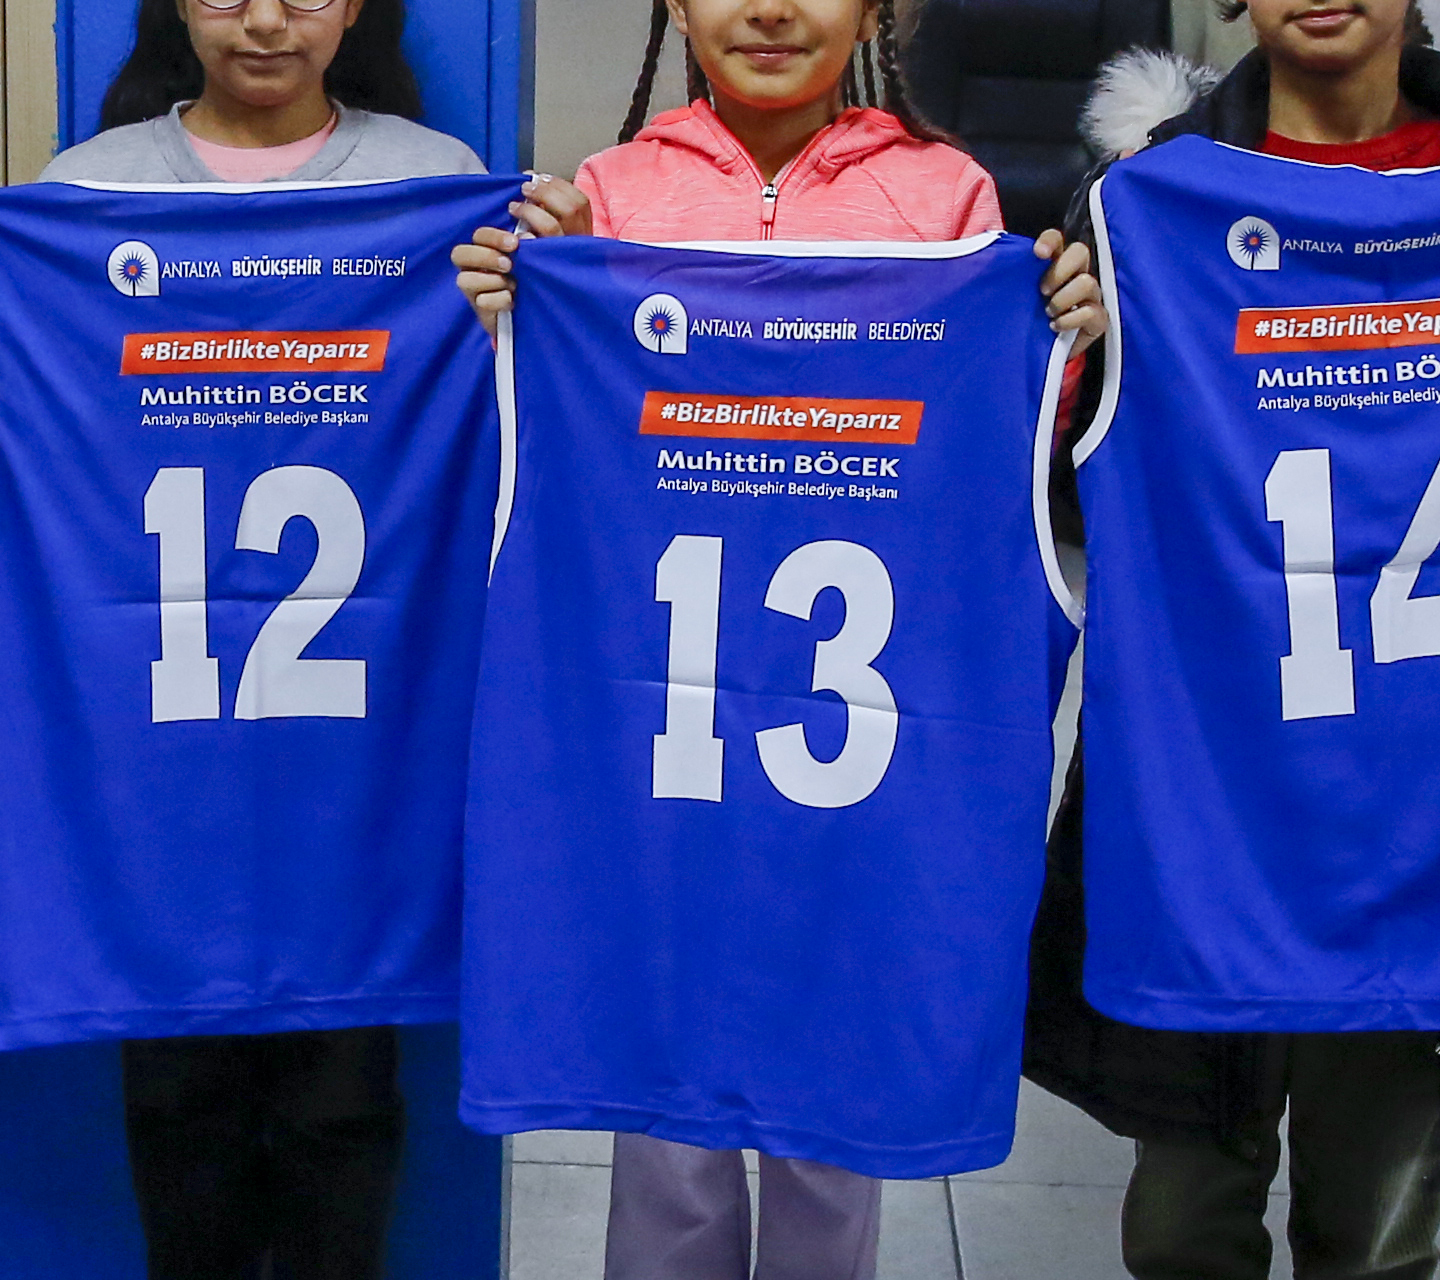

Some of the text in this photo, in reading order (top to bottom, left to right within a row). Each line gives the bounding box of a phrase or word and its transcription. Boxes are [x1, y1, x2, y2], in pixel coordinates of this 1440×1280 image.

[1282, 238, 1344, 254] ANTALYA
[161, 254, 406, 279] ANTALYA BÜYÜKŞEHİR BELEDİYESİ
[689, 317, 946, 344] ANTALYA BÜYÜKŞEHİR BELEDİYESİ
[140, 339, 369, 364] #BizBirlikteYaparız
[1256, 362, 1388, 389] Muhittin
[140, 381, 368, 406] Muhittin BÖCEK
[1258, 394, 1310, 412] Antalya
[1314, 391, 1390, 410] Büyükşehir
[141, 410, 369, 429] Antalya Büyükşehir Belediye Başkanı
[660, 402, 901, 434] #BizBirlikteYaparız
[657, 449, 900, 478] Muhittin BÖCEK
[657, 477, 898, 501] Antalya Büyükşehir Belediye Başkanı
[143, 465, 368, 722] 12
[651, 534, 899, 809] 13
